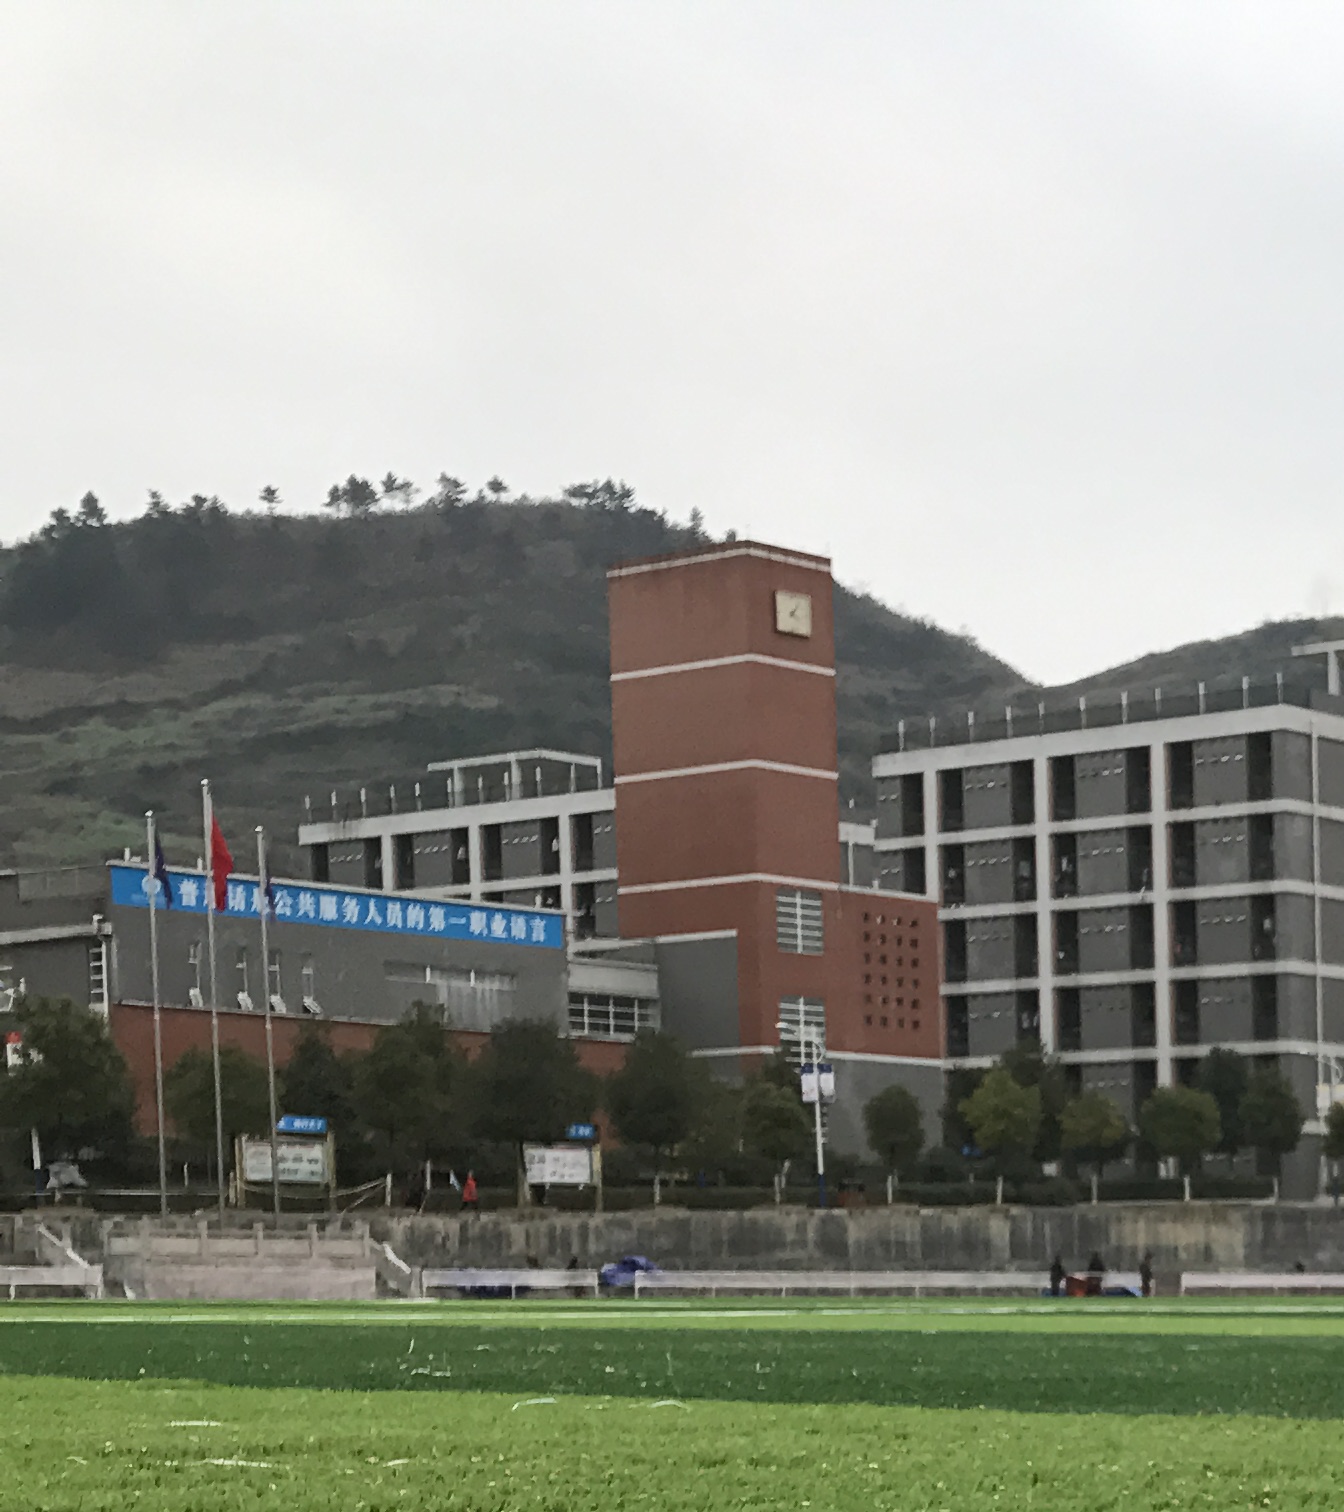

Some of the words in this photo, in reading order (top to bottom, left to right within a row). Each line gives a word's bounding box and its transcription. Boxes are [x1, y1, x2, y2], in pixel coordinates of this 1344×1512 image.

[178, 879, 546, 942] 普话是公共服务人员的第一职业语言
